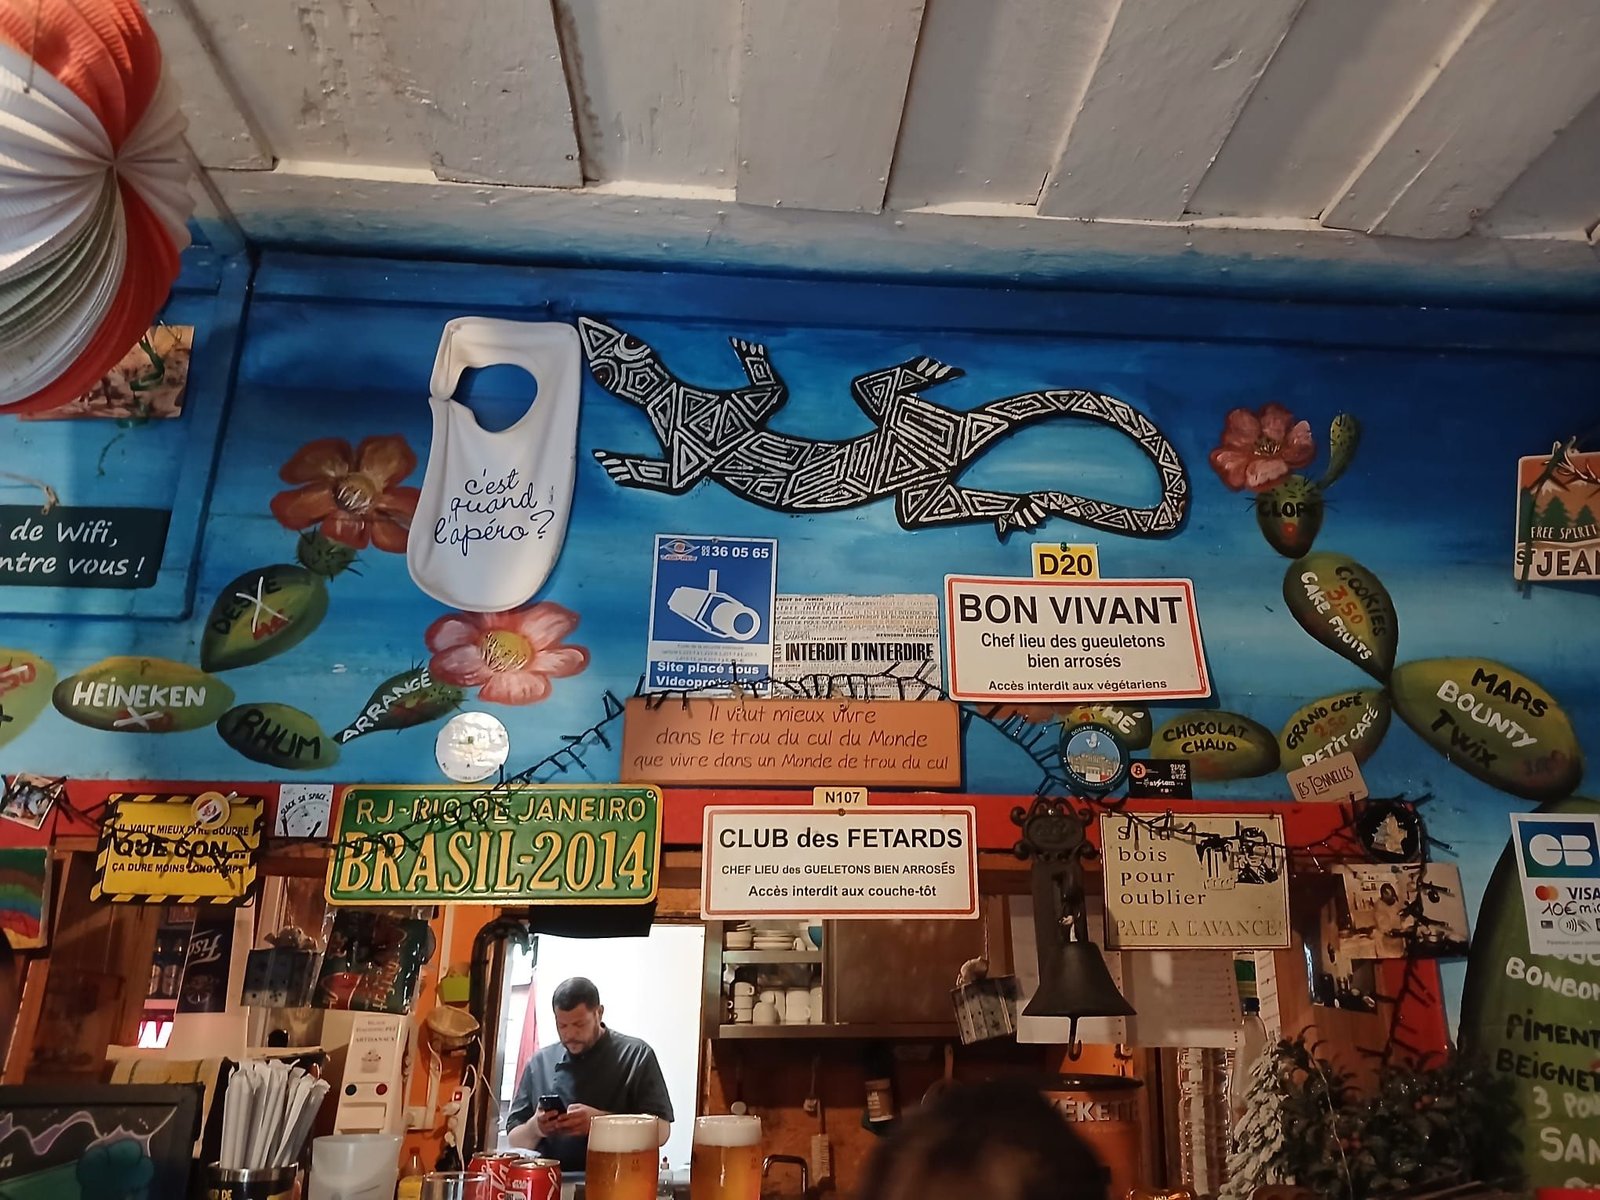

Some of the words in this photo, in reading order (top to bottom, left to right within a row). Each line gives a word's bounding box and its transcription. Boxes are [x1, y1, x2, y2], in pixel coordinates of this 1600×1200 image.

[465, 468, 520, 495] c'est
[451, 482, 537, 522] quand
[10, 518, 44, 544] de
[56, 519, 119, 548] Wifi,
[434, 515, 529, 557] l'apéro
[1531, 525, 1554, 539] FREE
[711, 545, 728, 557] 36
[731, 546, 749, 558] 05
[752, 548, 769, 559] 65
[68, 557, 128, 576] vous
[1039, 552, 1093, 577] D20
[1300, 571, 1331, 615] CAKE
[959, 593, 1038, 624] BON
[1048, 595, 1182, 625] VIVANT
[981, 632, 1015, 648] Chef
[1019, 633, 1046, 648] lieu
[1050, 633, 1077, 648] des
[1082, 633, 1165, 651] gueuletons
[785, 642, 848, 662] INTERDIT
[851, 643, 934, 662] D'INTERDIRE
[1027, 653, 1059, 668] bien
[1064, 652, 1121, 668] arrosés
[657, 661, 684, 673] Site
[688, 661, 724, 675] placé
[988, 679, 1024, 692] Accès
[1027, 679, 1069, 691] interdit
[1072, 683, 1094, 691] aux
[1097, 679, 1167, 692] végétariens
[1470, 667, 1549, 718] MARS
[709, 704, 719, 722] Il
[726, 705, 765, 723] vaut
[772, 707, 825, 724] mieux
[832, 706, 877, 724] vivre
[1286, 705, 1329, 751] GRAND
[1331, 690, 1364, 713] CAFÉ
[1350, 702, 1380, 741] CAFÉ
[1436, 679, 1538, 749] BOUNTY
[232, 708, 321, 760] RHUM
[655, 727, 701, 746] dans
[709, 729, 725, 746] le
[731, 729, 770, 746] trou
[777, 728, 800, 746] du
[807, 729, 834, 747] cul
[839, 729, 861, 748] du
[867, 730, 929, 748] Monde
[1162, 721, 1250, 743] CHOCOLAT
[1181, 738, 1238, 754] CHAUD
[633, 753, 664, 769] que
[670, 753, 709, 768] vivre
[714, 752, 752, 768] dans
[758, 756, 776, 768] un
[781, 753, 832, 769] Monde
[837, 754, 858, 769] de
[863, 754, 896, 770] trou
[901, 755, 922, 770] du
[927, 755, 949, 771] cul
[825, 791, 860, 804] N107
[518, 797, 647, 823] JANEIRO
[156, 825, 185, 836] MIEUX
[719, 828, 789, 849] CLUB
[797, 827, 839, 849] des
[847, 828, 963, 849] FETARDS
[337, 830, 648, 894] BRASIL-2014
[1118, 846, 1167, 862] bois
[112, 862, 125, 873] ÇA
[128, 862, 153, 873] DURE
[155, 863, 185, 873] MOINS
[721, 864, 752, 875] CHEF
[754, 864, 780, 875] LIEU
[782, 865, 801, 875] des
[804, 864, 871, 875] GUELETONS
[873, 864, 899, 875] BIEN
[902, 861, 956, 875] ARROSÉS
[1120, 870, 1175, 887] pour
[748, 884, 788, 897] Accès
[792, 885, 838, 897] interdit
[841, 887, 864, 897] aux
[868, 884, 937, 897] couche-tôt
[1120, 889, 1207, 905] oublier
[1116, 919, 1159, 937] PAIE
[1166, 919, 1181, 937] A
[1532, 1085, 1552, 1120] 3
